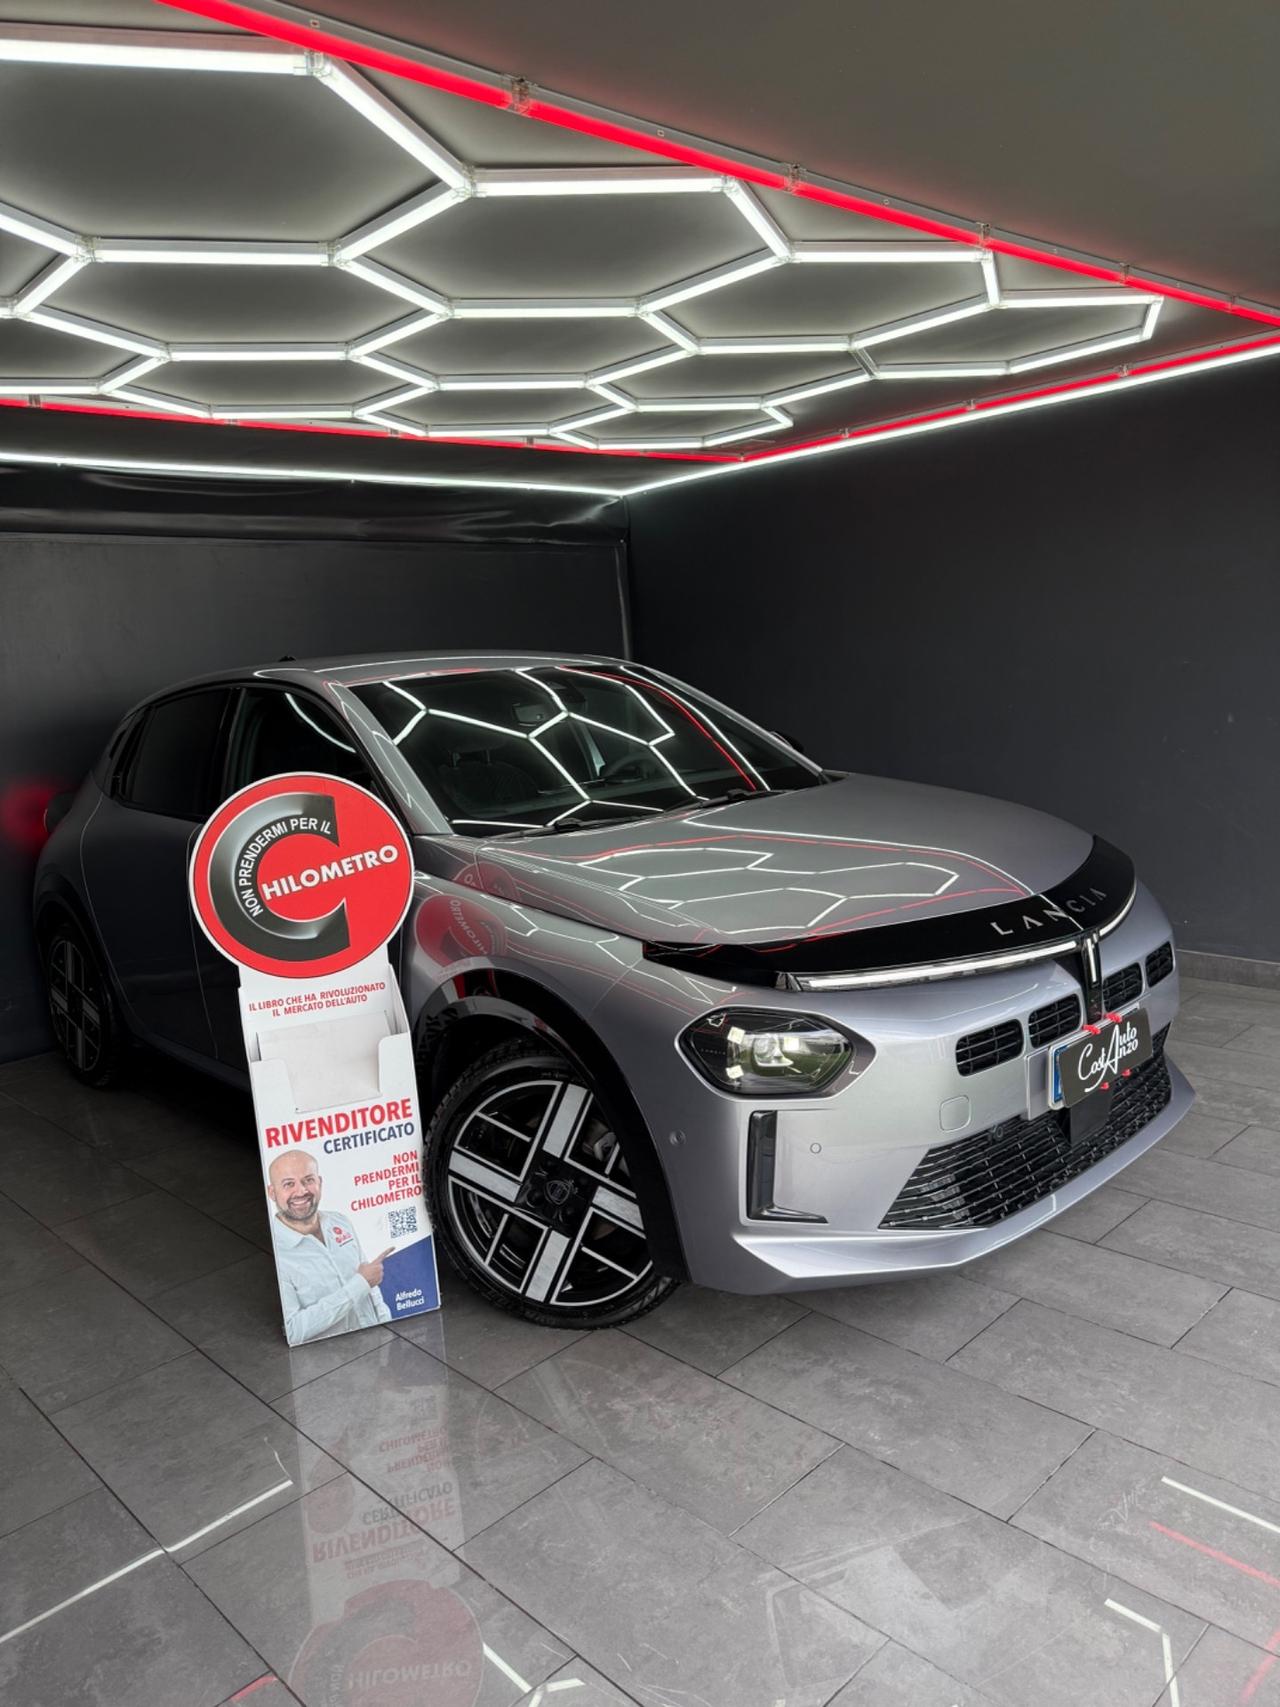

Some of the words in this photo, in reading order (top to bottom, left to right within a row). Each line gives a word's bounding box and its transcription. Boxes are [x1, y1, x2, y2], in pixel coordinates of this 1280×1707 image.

[289, 817, 318, 831] PER
[320, 820, 331, 834] IL
[238, 821, 288, 886] PRENDERMI
[241, 888, 263, 917] NON
[990, 887, 1107, 936] LANCIA
[249, 1003, 257, 1012] IL
[258, 1000, 284, 1010] LIBRO
[285, 996, 303, 1007] CHE
[304, 993, 317, 1004] HA
[320, 981, 386, 1000] RIVOLUZIONATO
[272, 1009, 281, 1017] IL
[284, 1002, 324, 1015] MERCATO
[325, 994, 368, 1009] DELL'AUTO
[265, 1098, 413, 1148] RIVENDITORE
[323, 1121, 415, 1155] CERTIFICATO
[393, 1150, 418, 1165] NON
[354, 1161, 420, 1186] PRENDERMI
[388, 1176, 409, 1190] PER
[411, 1174, 422, 1185] IL
[350, 1185, 422, 1212] CHILOMETRO
[395, 1288, 422, 1301] Alfredo
[396, 1296, 425, 1311] Bellucci
